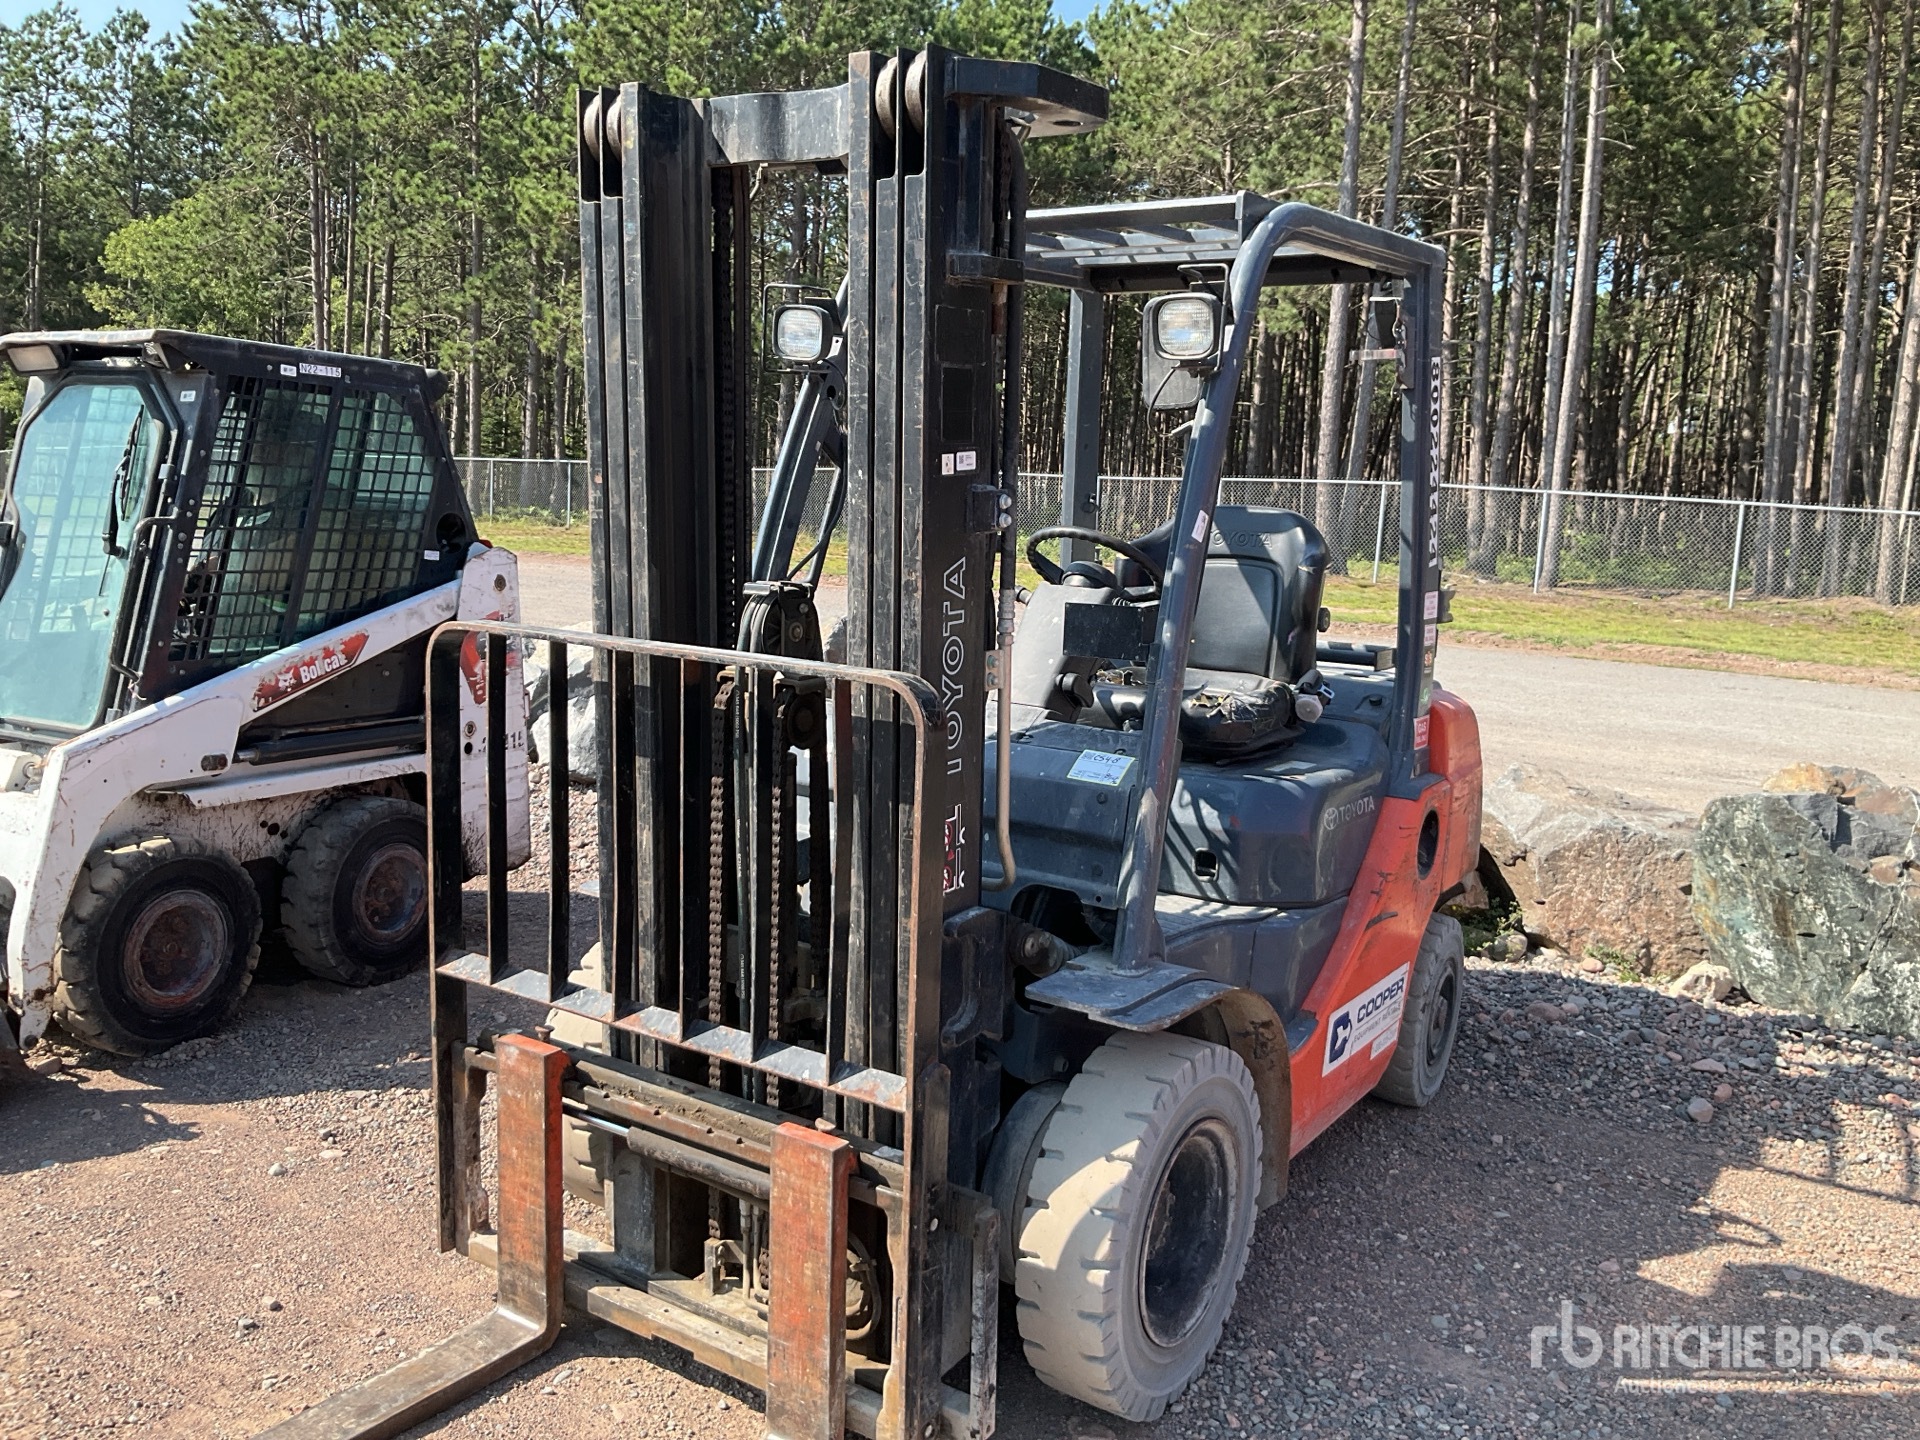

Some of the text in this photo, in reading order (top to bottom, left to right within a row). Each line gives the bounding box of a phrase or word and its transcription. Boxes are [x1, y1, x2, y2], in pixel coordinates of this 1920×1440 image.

[301, 363, 341, 377] N22-115
[1208, 529, 1273, 549] OYOTA
[1339, 795, 1375, 821] TOYOTA
[1357, 976, 1405, 1023] COOPER
